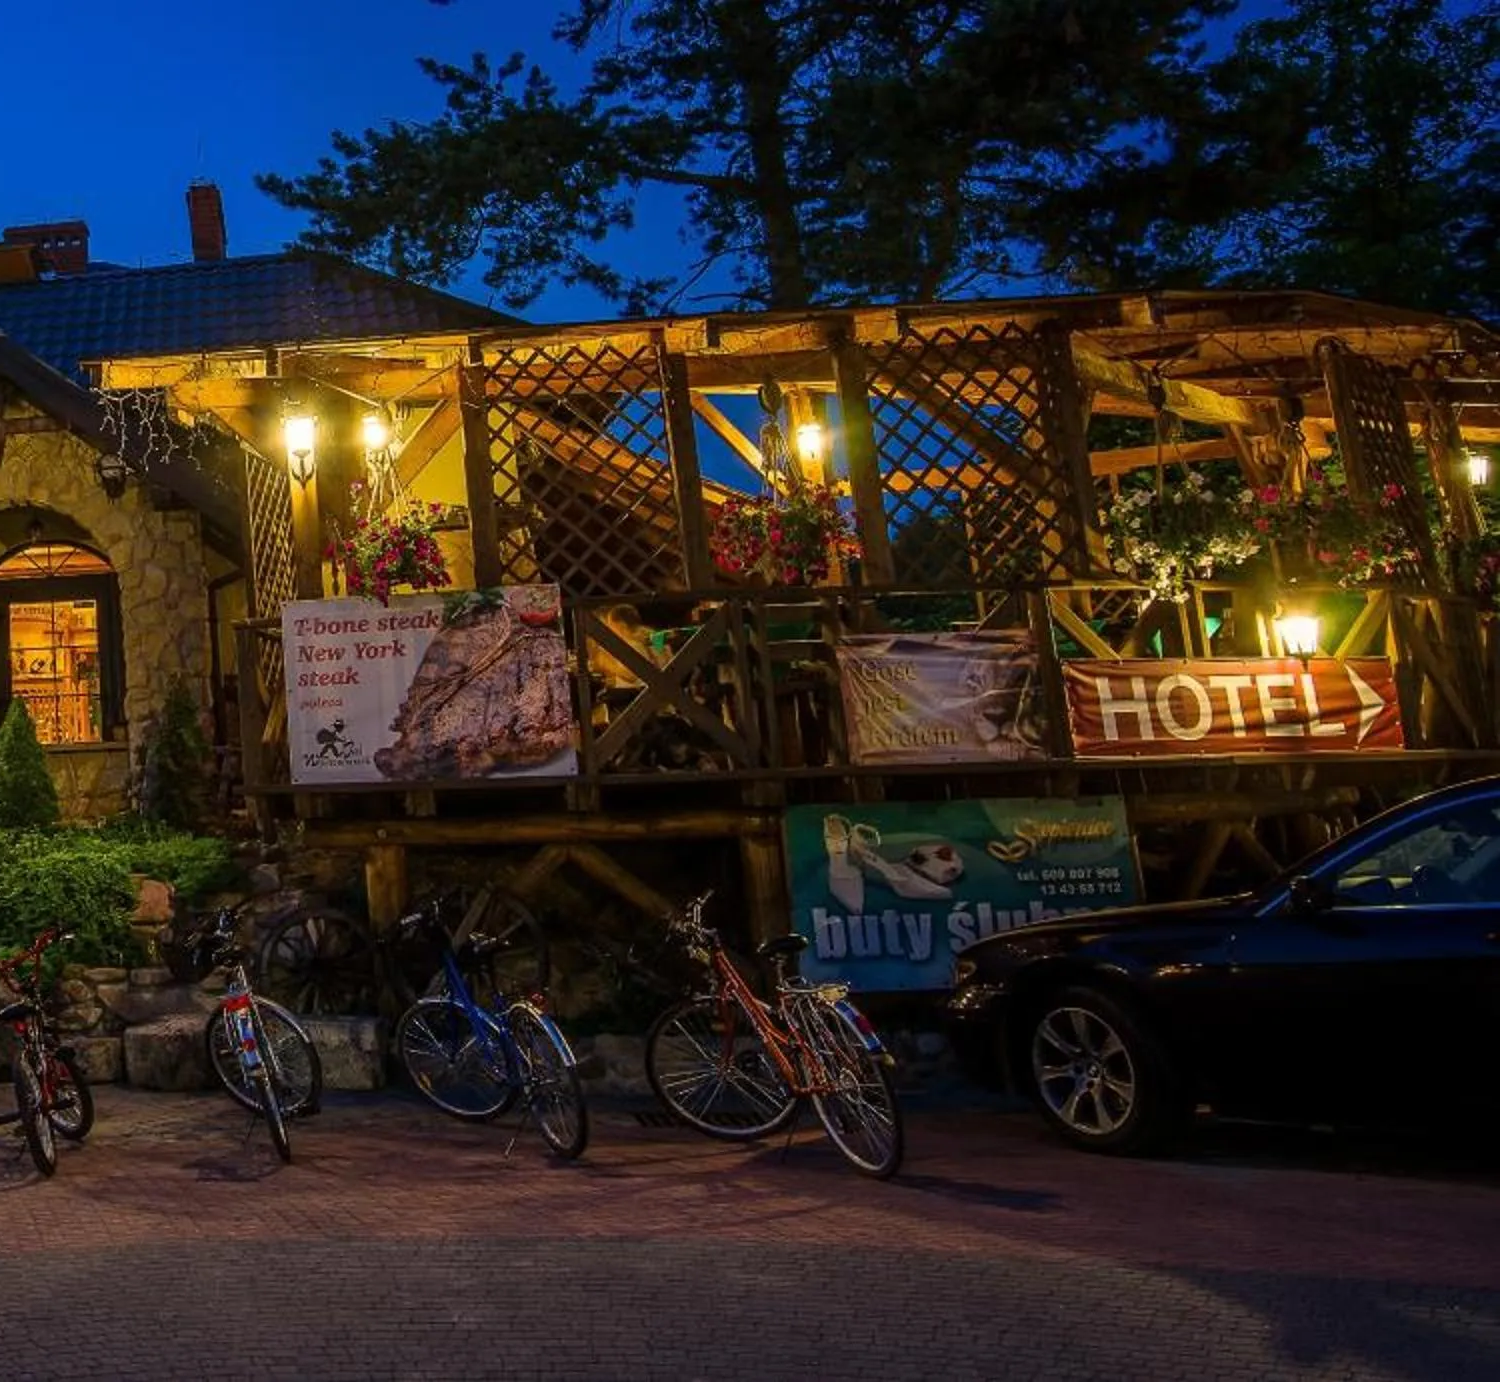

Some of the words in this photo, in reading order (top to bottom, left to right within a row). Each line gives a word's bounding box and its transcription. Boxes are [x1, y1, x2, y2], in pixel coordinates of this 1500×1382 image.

[294, 614, 369, 636] T-bone
[377, 609, 439, 632] steak
[297, 647, 345, 664] New
[354, 640, 406, 661] York
[297, 667, 360, 687] steak
[1096, 674, 1346, 740] HOTEL
[1016, 869, 1040, 881] tel.
[810, 907, 932, 961] buty
